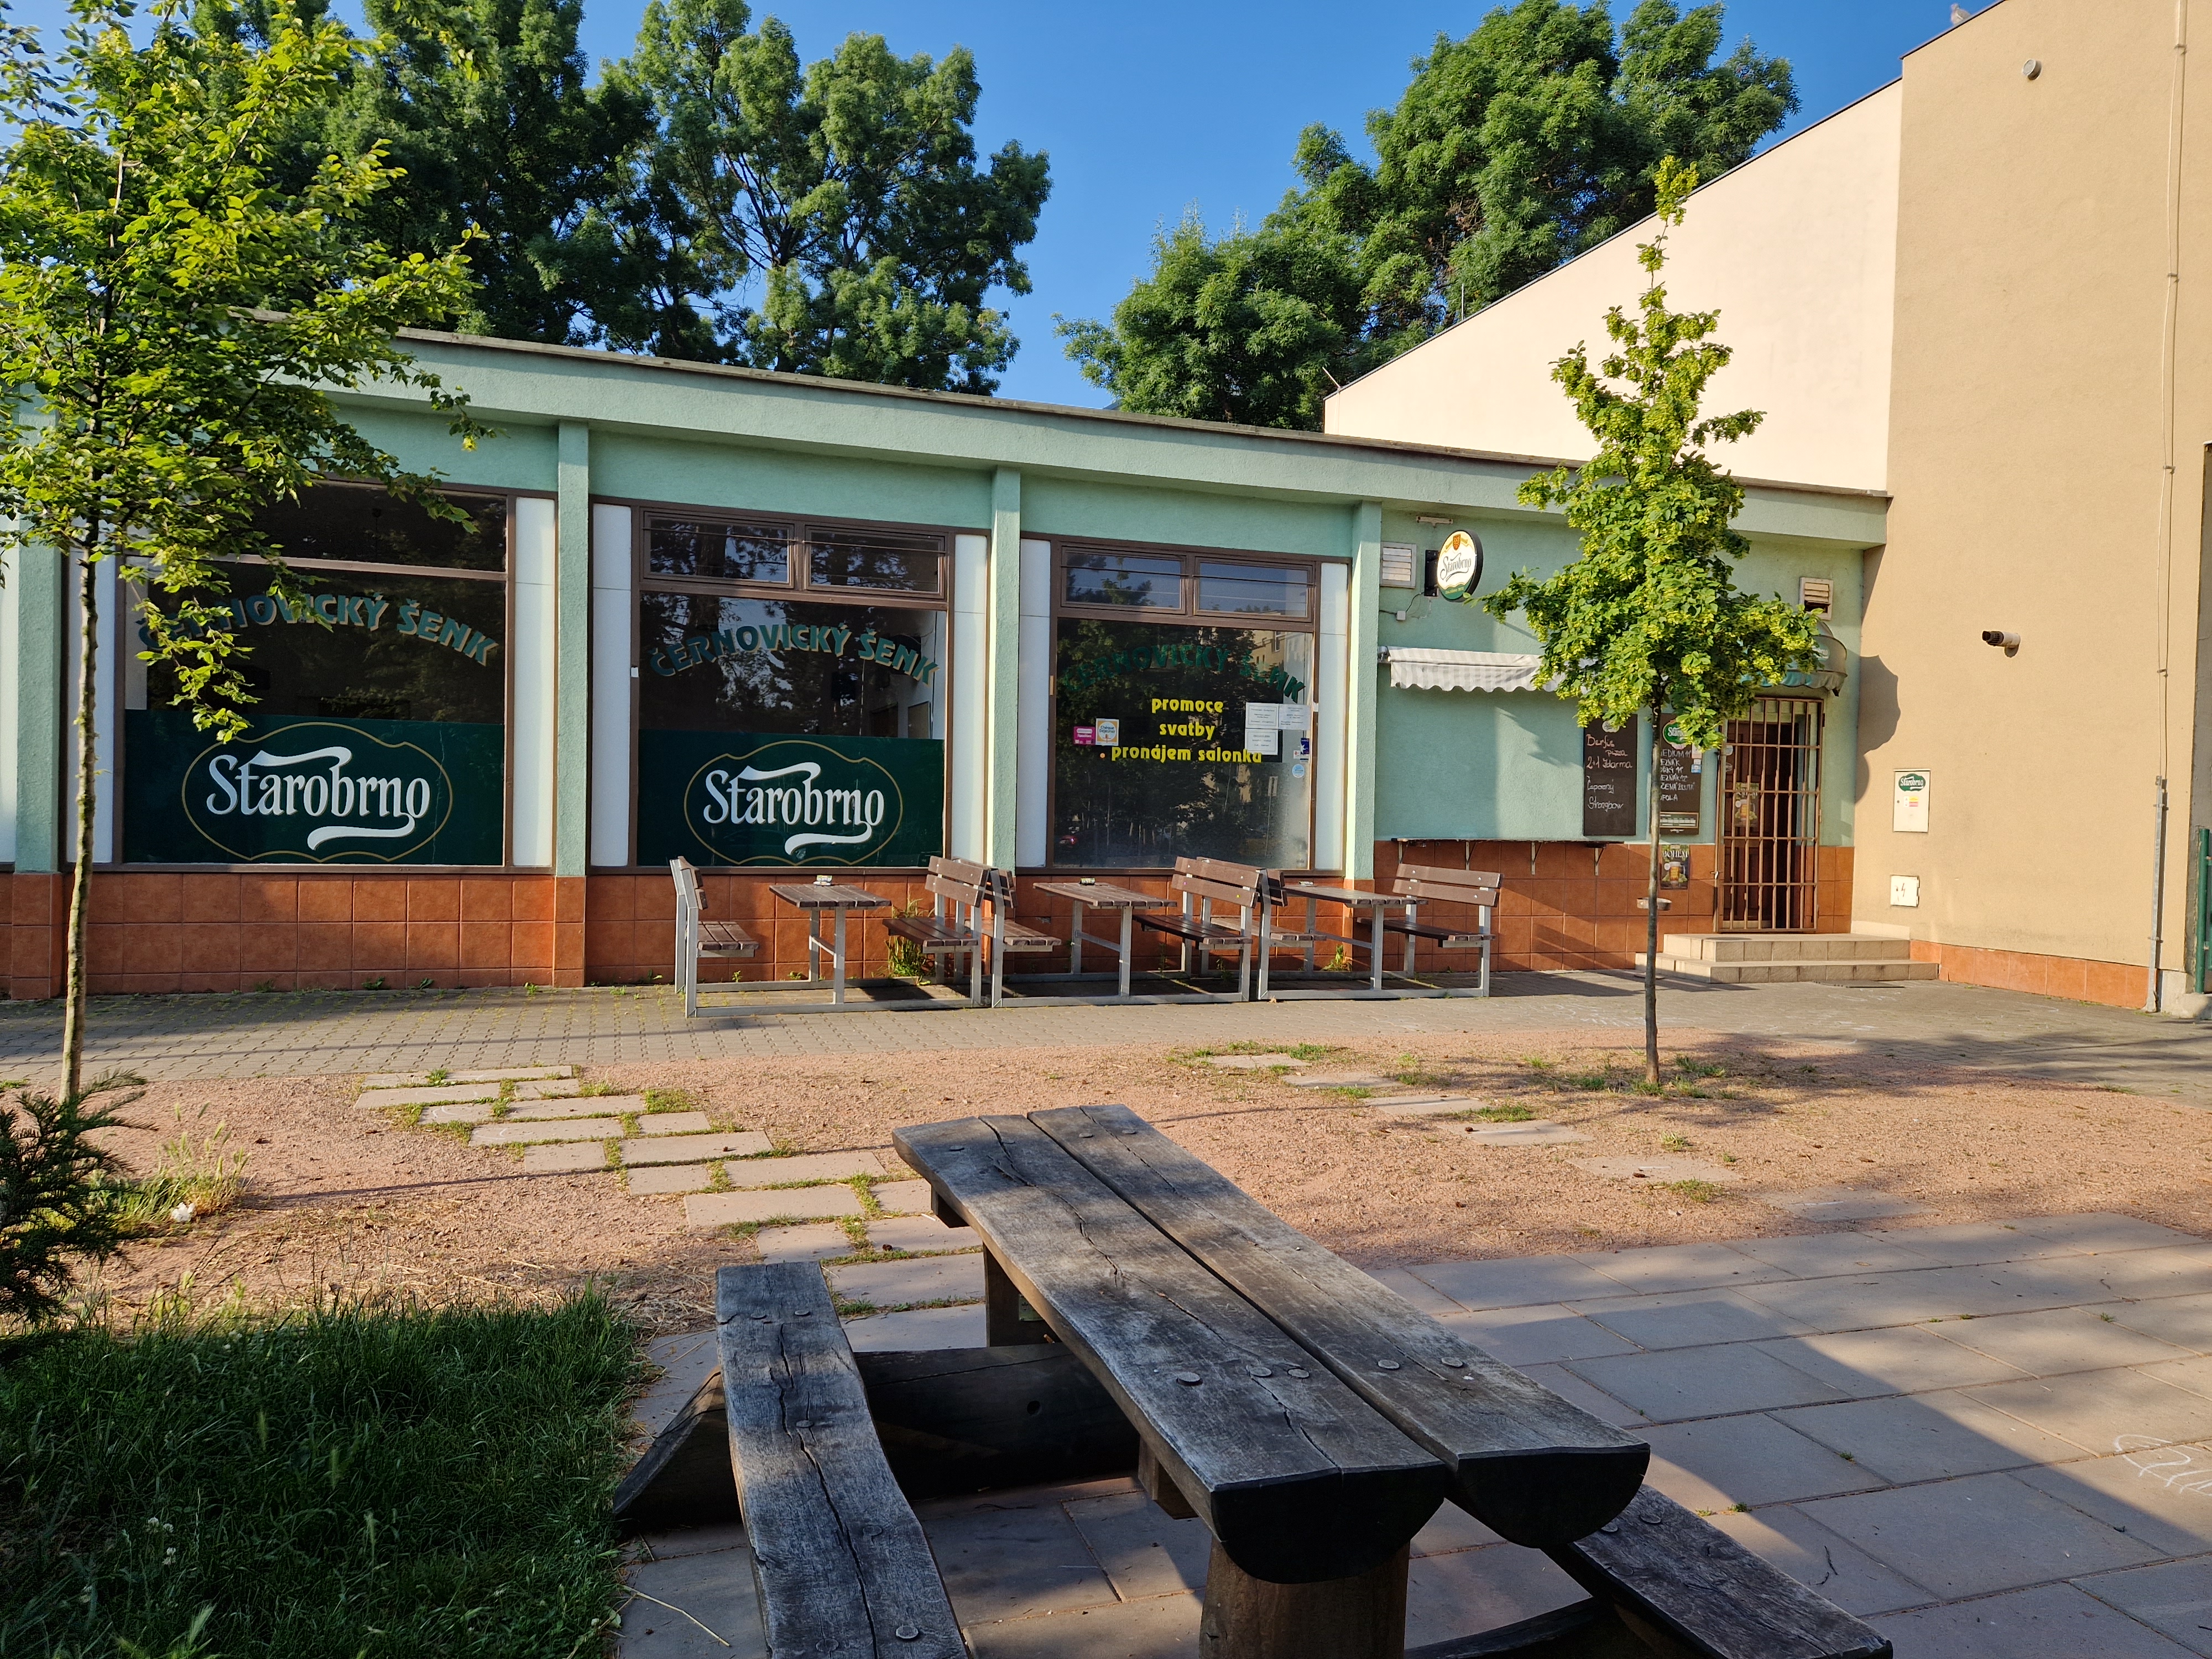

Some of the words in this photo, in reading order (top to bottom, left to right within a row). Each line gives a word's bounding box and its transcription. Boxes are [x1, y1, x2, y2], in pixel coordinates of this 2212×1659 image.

[1440, 552, 1472, 582] Starobrno
[397, 598, 499, 666] ŠENK
[648, 623, 852, 677] ČERNOVICKÝ
[858, 628, 941, 687] ŠENK
[1151, 698, 1224, 714] promoce
[1159, 721, 1215, 740] svatby
[1112, 744, 1191, 763] pronájem
[1198, 747, 1263, 763] salonku
[1586, 755, 1600, 769] 2+1
[206, 746, 431, 851] Starobrno
[703, 761, 885, 856] Starobrno
